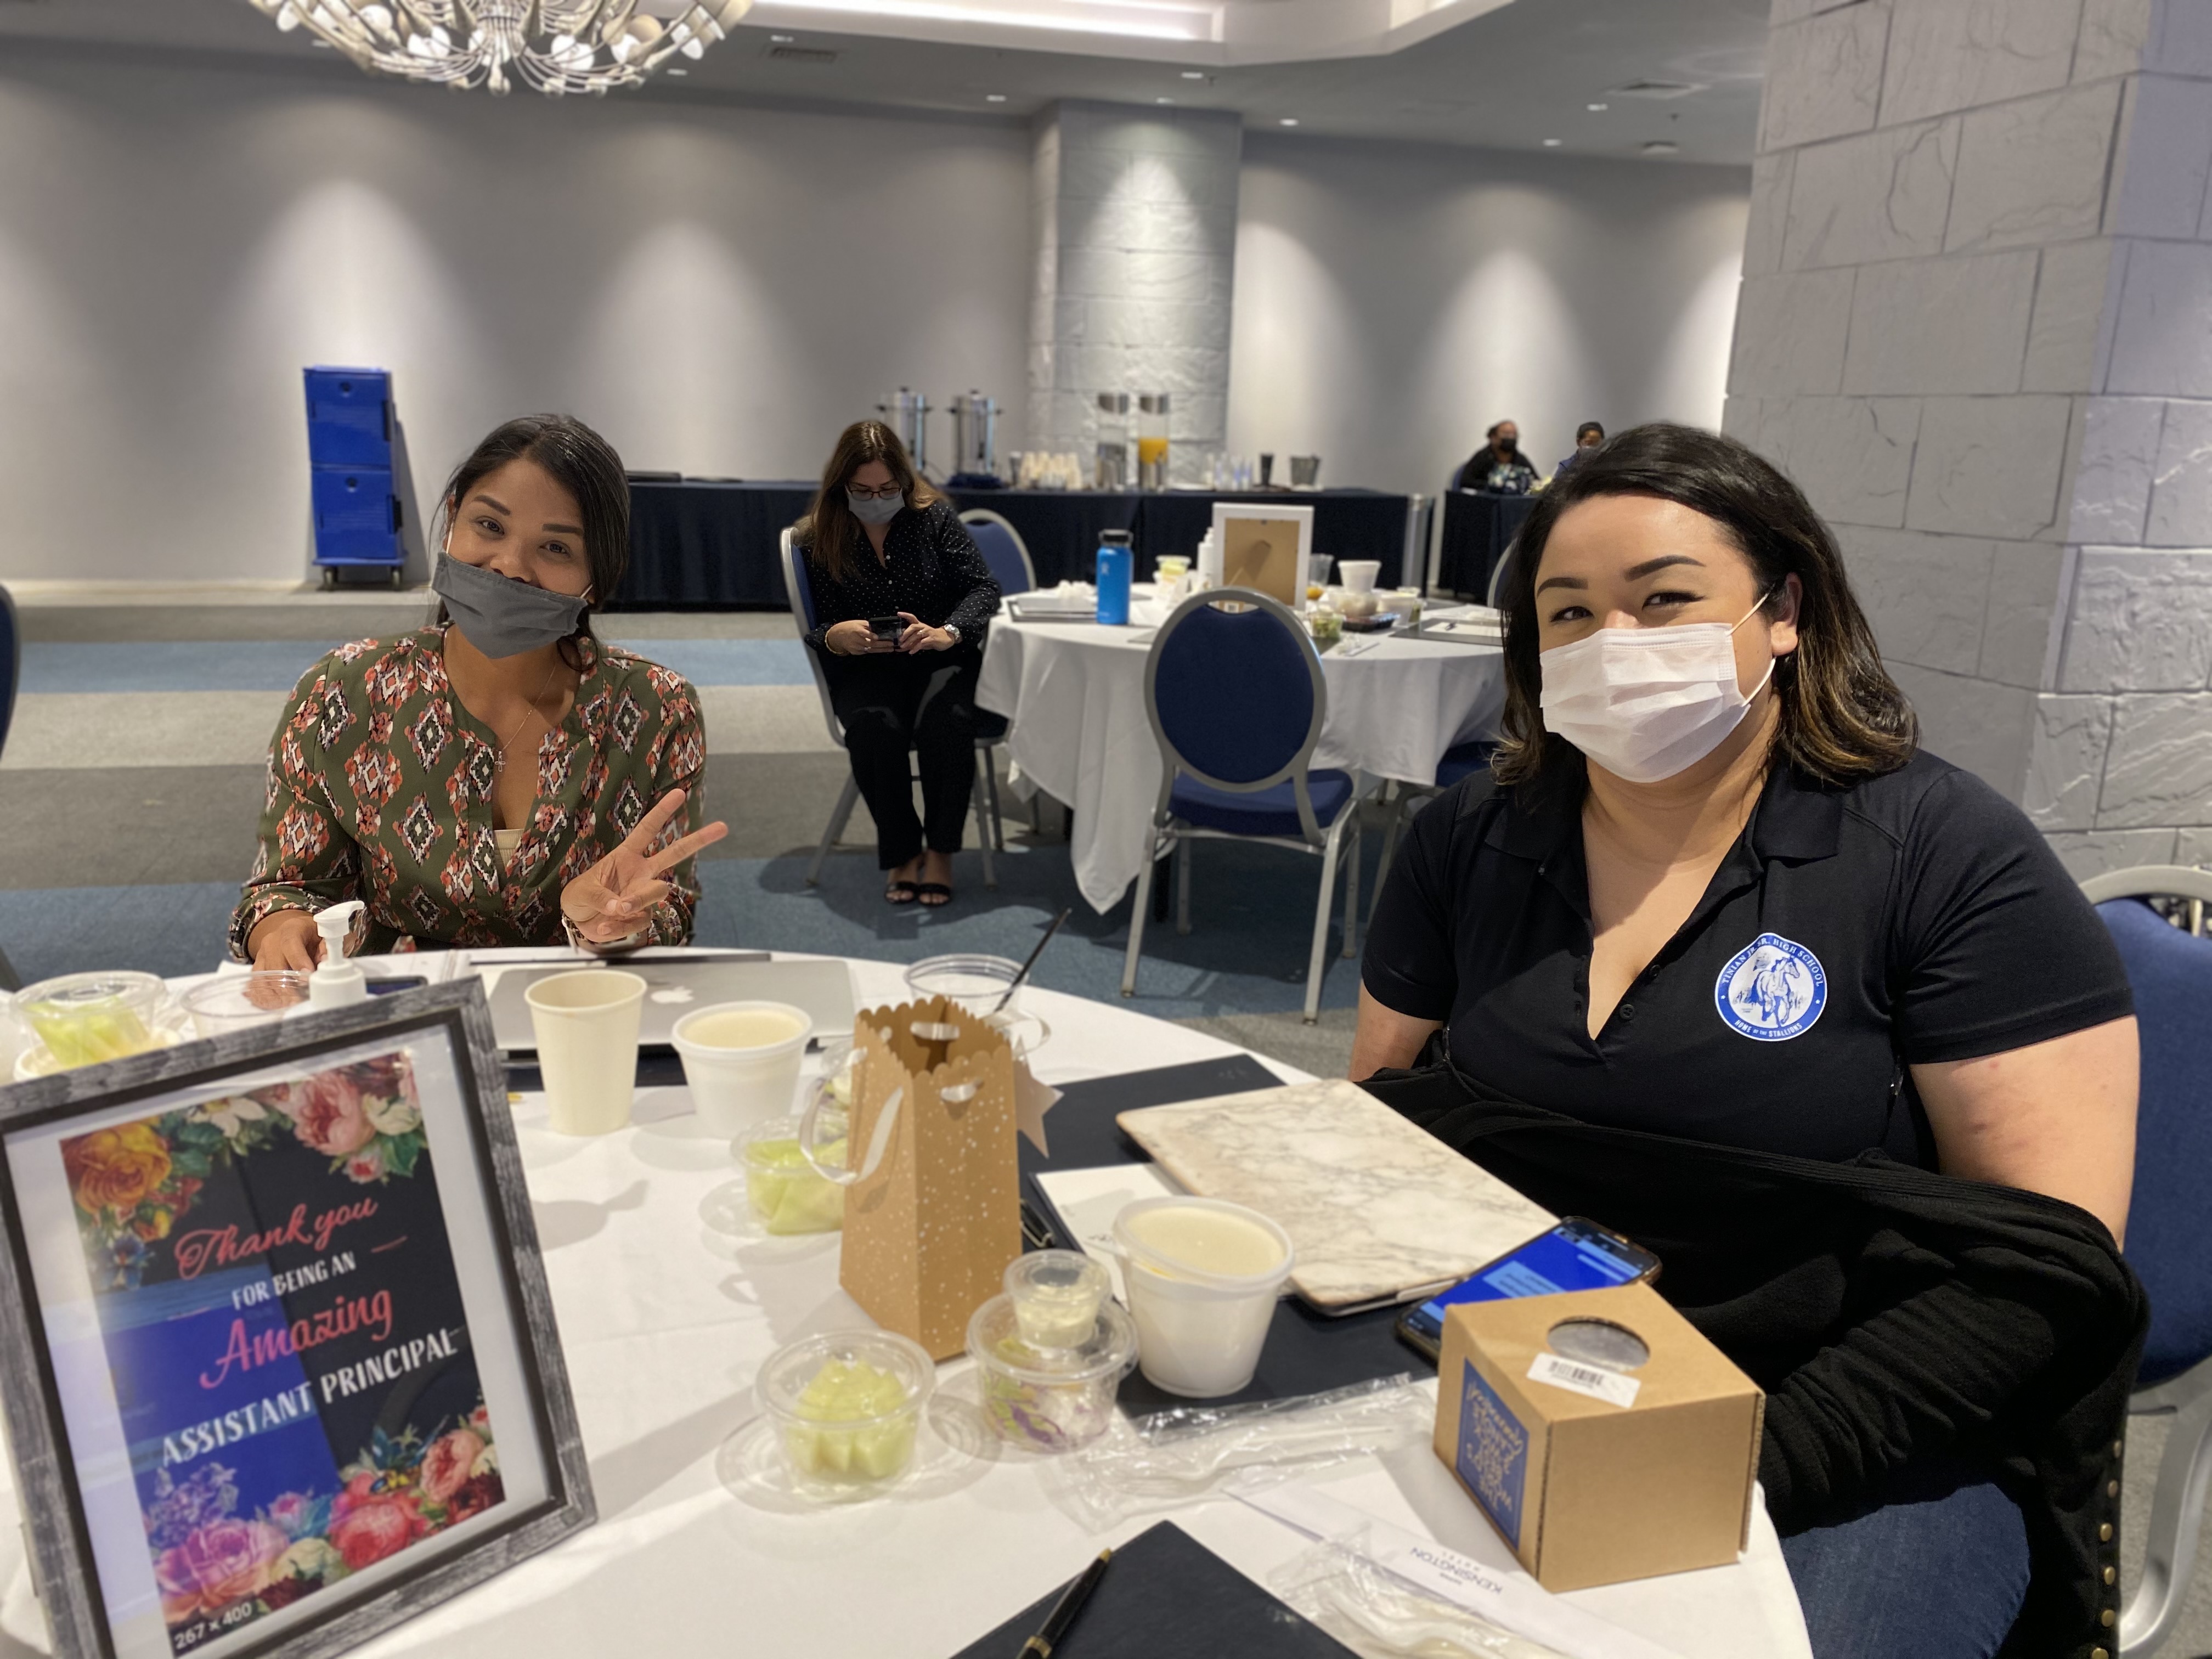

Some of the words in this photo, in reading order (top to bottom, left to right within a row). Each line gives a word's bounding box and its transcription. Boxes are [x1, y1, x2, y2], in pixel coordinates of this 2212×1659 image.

[1722, 954, 1747, 984] TINIAN
[1773, 938, 1797, 954] HIGH
[1797, 950, 1824, 987] SCHOOL
[1734, 1019, 1752, 1033] HOME
[1768, 1023, 1803, 1037] STALLIONS
[174, 1203, 313, 1281] Thank
[313, 1197, 379, 1251] you
[232, 1280, 270, 1311] FOR
[272, 1260, 329, 1297] BEING
[331, 1250, 357, 1277] AN
[199, 1289, 393, 1390] Amazing
[162, 1381, 312, 1467] ASSISTANT
[320, 1328, 458, 1403] PRINCIPAL
[1410, 1546, 1503, 1594] KENSINGTON
[174, 1622, 206, 1649] 267
[222, 1602, 252, 1625] 400
